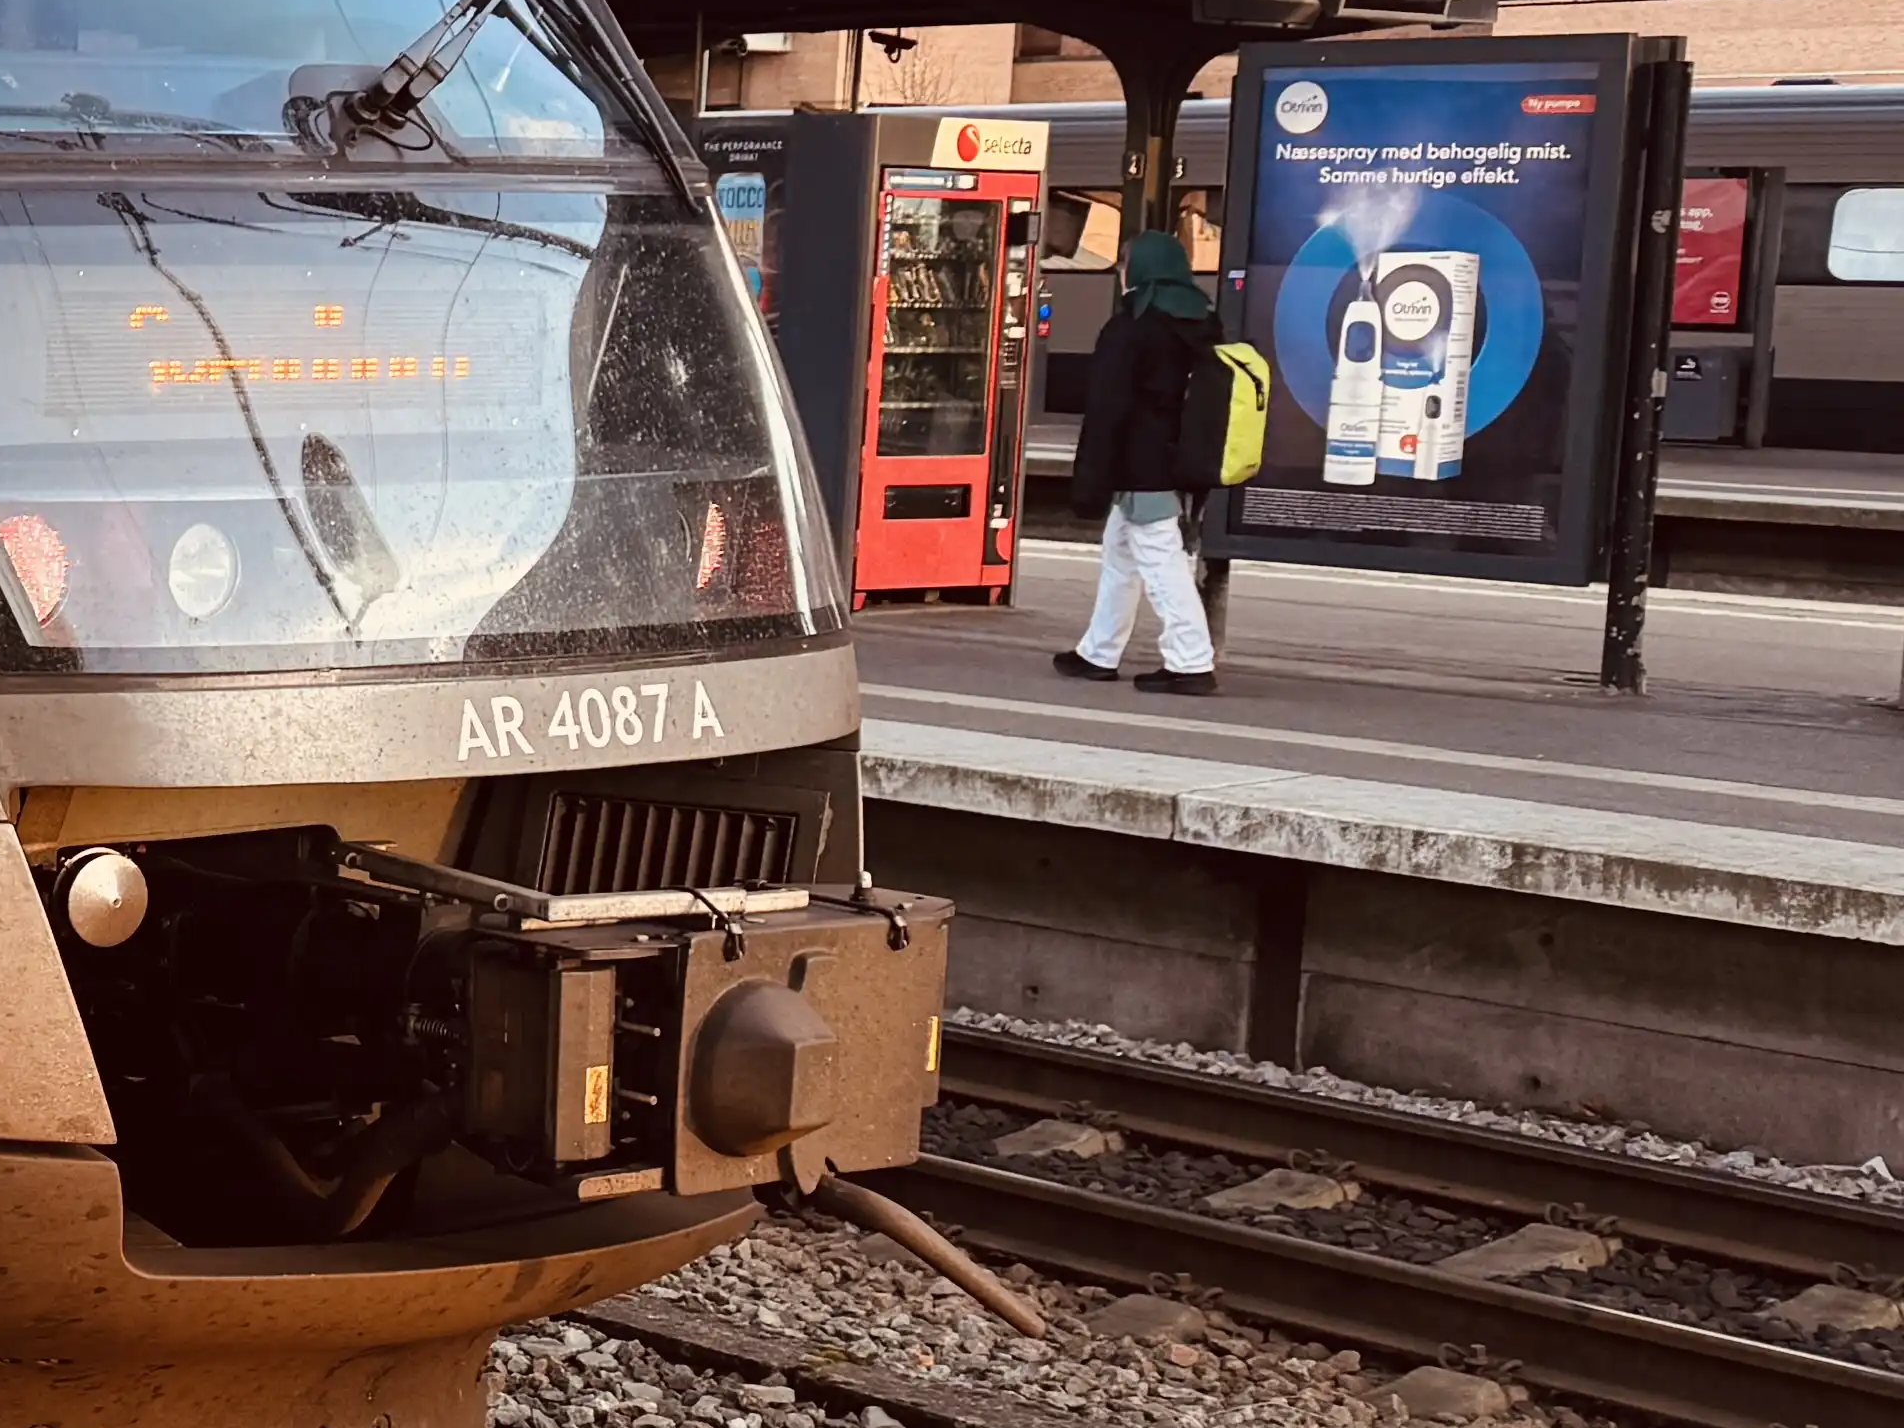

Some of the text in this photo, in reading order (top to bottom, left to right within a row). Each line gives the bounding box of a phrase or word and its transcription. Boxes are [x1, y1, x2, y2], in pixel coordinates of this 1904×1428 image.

[983, 136, 1032, 155] selecta
[1275, 143, 1571, 164] Næsespray med behagelig mist.
[1319, 167, 1520, 189] Samme hurtige effekt.
[458, 680, 725, 762] AR 4087 A
